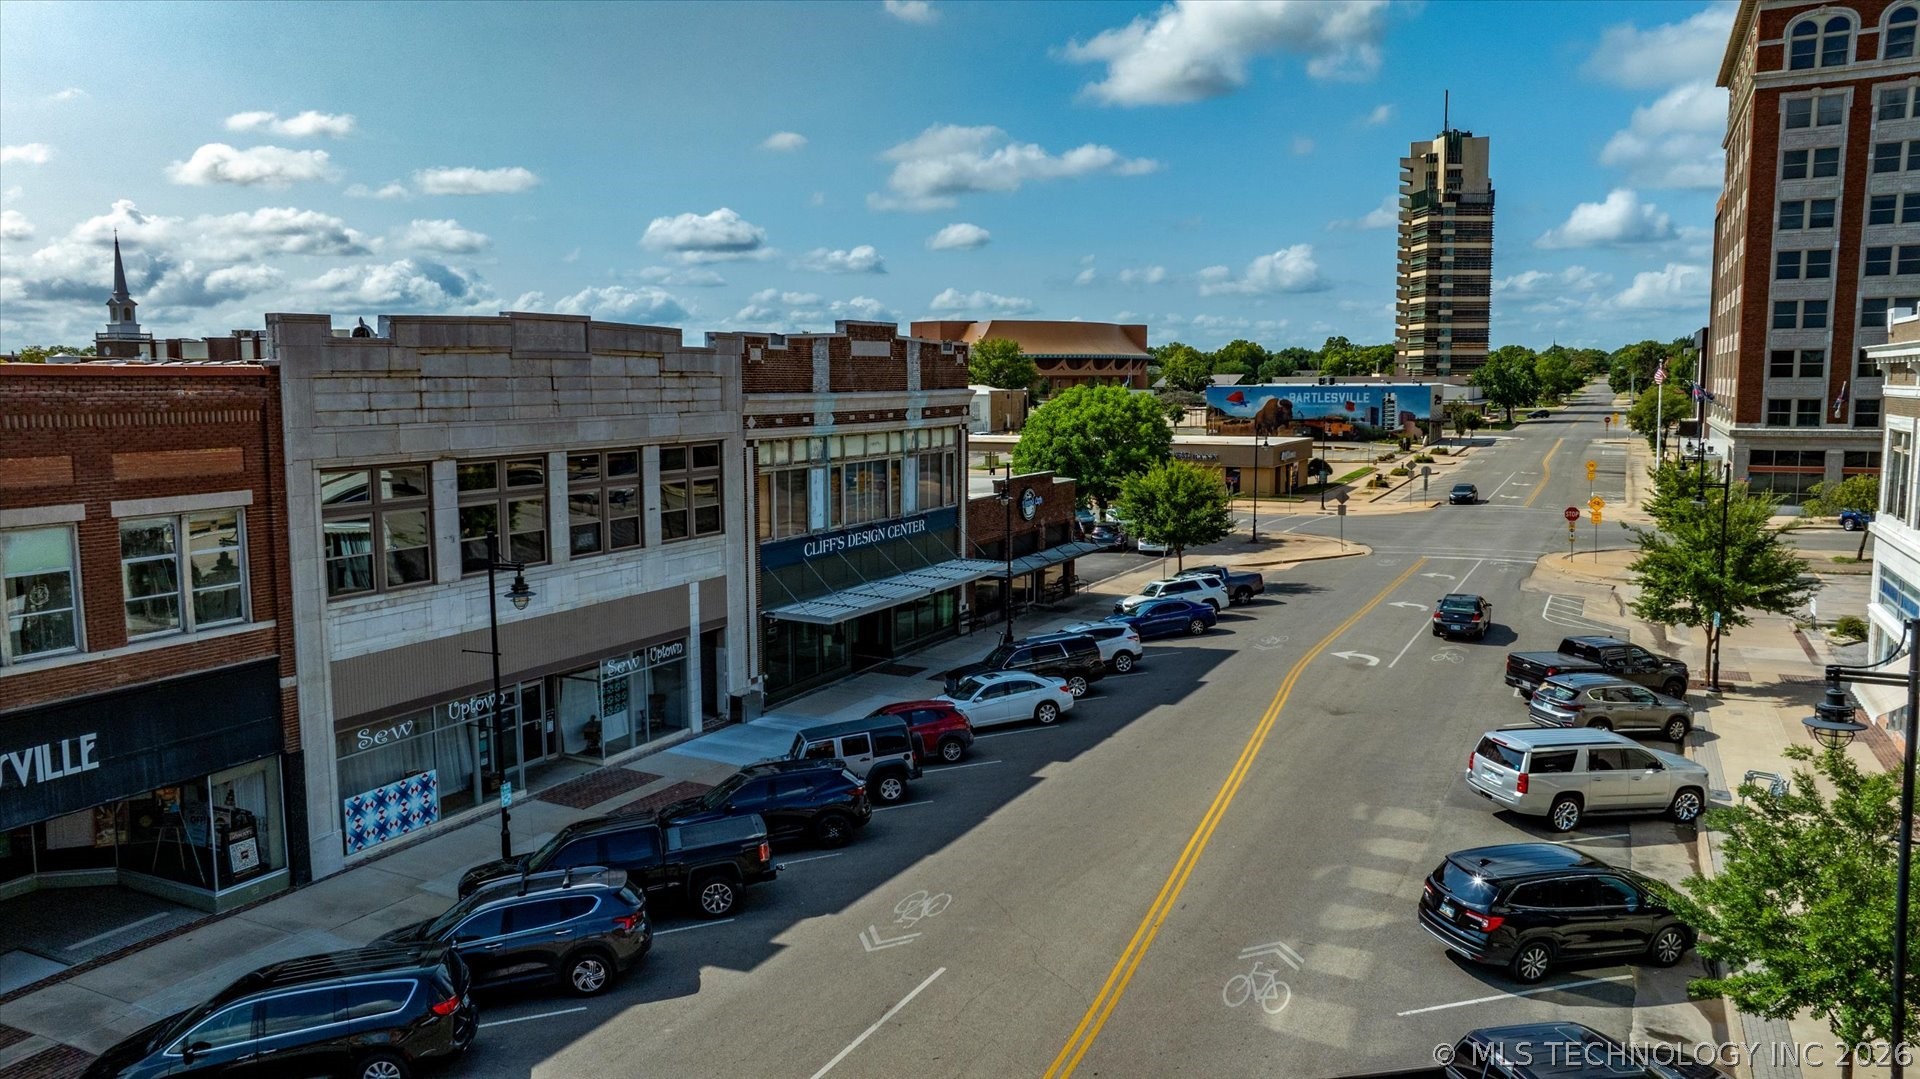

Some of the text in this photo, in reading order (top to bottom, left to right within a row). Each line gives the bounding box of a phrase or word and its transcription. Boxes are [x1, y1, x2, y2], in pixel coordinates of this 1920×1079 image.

[1289, 392, 1370, 403] BARTLESVILLE
[804, 519, 925, 557] CLIFF'S DESIGN CENTER
[607, 643, 682, 676] Sew Uptown
[357, 719, 413, 750] Sew
